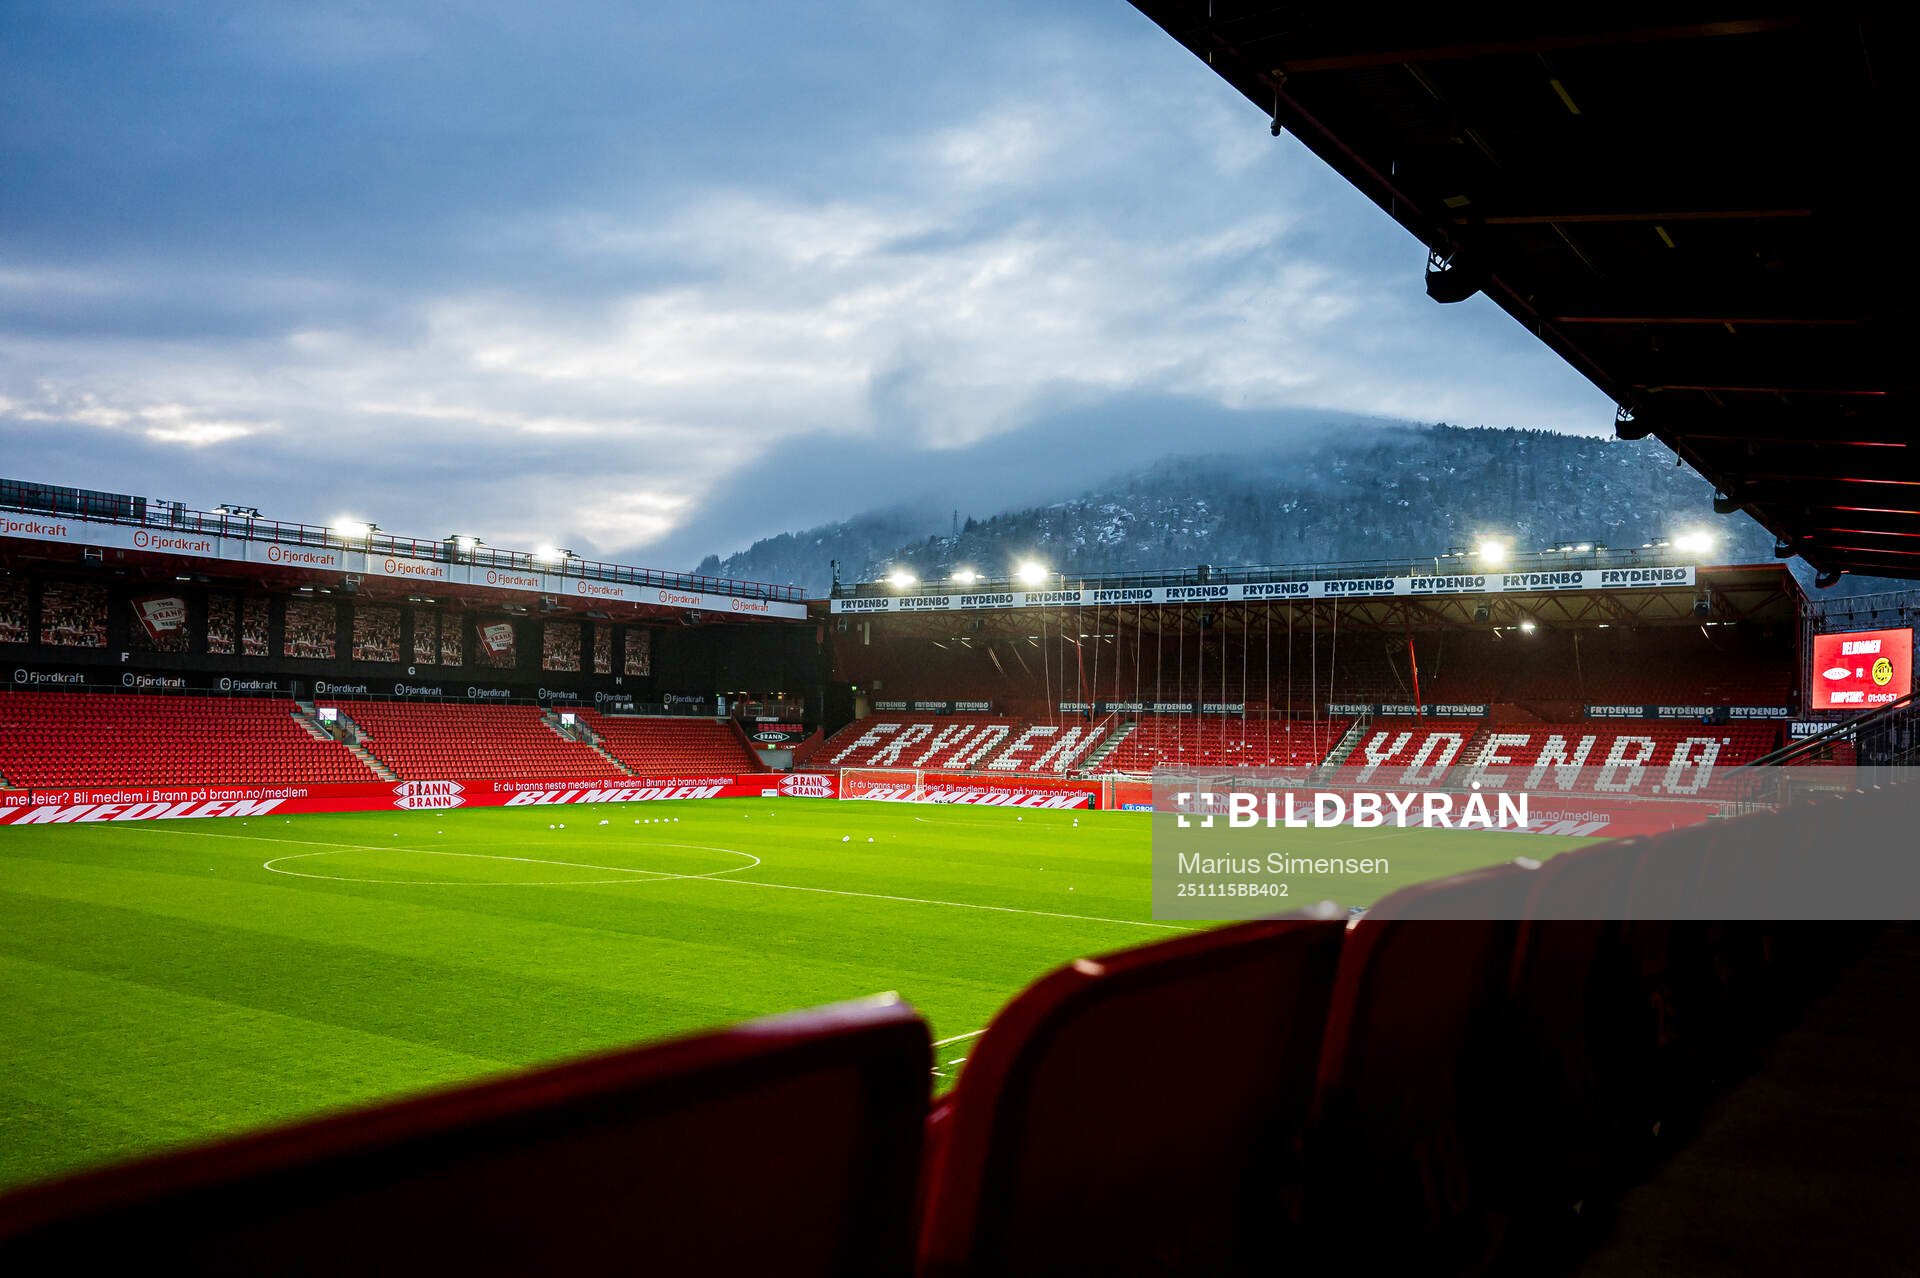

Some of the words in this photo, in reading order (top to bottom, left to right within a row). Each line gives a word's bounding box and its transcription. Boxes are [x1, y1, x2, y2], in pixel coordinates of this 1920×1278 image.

[151, 535, 211, 552] Fjordkraft
[283, 550, 335, 565] Fjordkraft
[397, 562, 443, 577] Fjordkraft
[1601, 568, 1687, 583] FRYDENBØ
[498, 574, 539, 587] Fjordkraft
[1410, 575, 1486, 590] FRYDENBØ
[1503, 571, 1583, 587] FRYDENBØ
[587, 584, 624, 597] Fjordkraft
[1166, 585, 1229, 598] FRYDENBØ
[1243, 581, 1309, 597] FRYDENBØ
[1324, 578, 1395, 593] FRYDENBØ
[668, 593, 700, 605] Fjordkraft
[961, 593, 1013, 605] FRYDENBØ
[1025, 591, 1081, 603] FRYDENBØ
[1094, 588, 1153, 601] FRYDENBØ
[740, 601, 769, 612] Fjordkraft
[841, 598, 888, 609] FRYDENBØ
[900, 596, 949, 607] FRYDENBØ
[121, 652, 130, 662] F
[408, 666, 416, 675] G
[30, 671, 85, 684] Fjordkraft
[136, 675, 186, 688] Fjordkraft
[615, 676, 622, 685] H
[232, 680, 278, 691] Fjordkraft
[326, 684, 367, 694] Fjordkraft
[405, 686, 442, 696] Fjordkraft
[477, 688, 510, 698] Fjordkraft
[546, 690, 578, 700] Fjordkraft
[1382, 704, 1428, 712] FRYDENØ
[1436, 704, 1484, 713] FRYDENBØ
[1590, 706, 1643, 714] FRYDENBØ
[1658, 706, 1714, 715] FRYDENBØ
[1729, 706, 1788, 715] FRYDENBØ
[494, 782, 502, 792] Er
[503, 781, 514, 791] du
[515, 781, 543, 791] branns
[545, 781, 566, 790] neste
[568, 779, 602, 789] medeier?
[604, 778, 613, 788] Bli
[614, 778, 641, 787] medlem
[646, 777, 666, 787] Brann
[667, 777, 677, 787] på
[677, 776, 733, 787] brann.no/medlem
[793, 777, 823, 787] BRANN
[73, 791, 89, 804] Bli
[92, 790, 143, 803] medlem
[153, 790, 187, 801] Brann
[191, 788, 207, 802] på
[210, 787, 308, 800] brann.no/medlem
[408, 783, 451, 796] BRANN
[793, 787, 824, 796] BRANN
[946, 784, 955, 792] Bli
[956, 785, 984, 794] medlem
[990, 786, 1011, 795] Brann
[408, 796, 451, 808] BRANN
[504, 790, 580, 806] BLI
[574, 786, 724, 804] MEDLEM
[925, 790, 1088, 808] MEDLEM
[9, 799, 287, 825] MEDLEM
